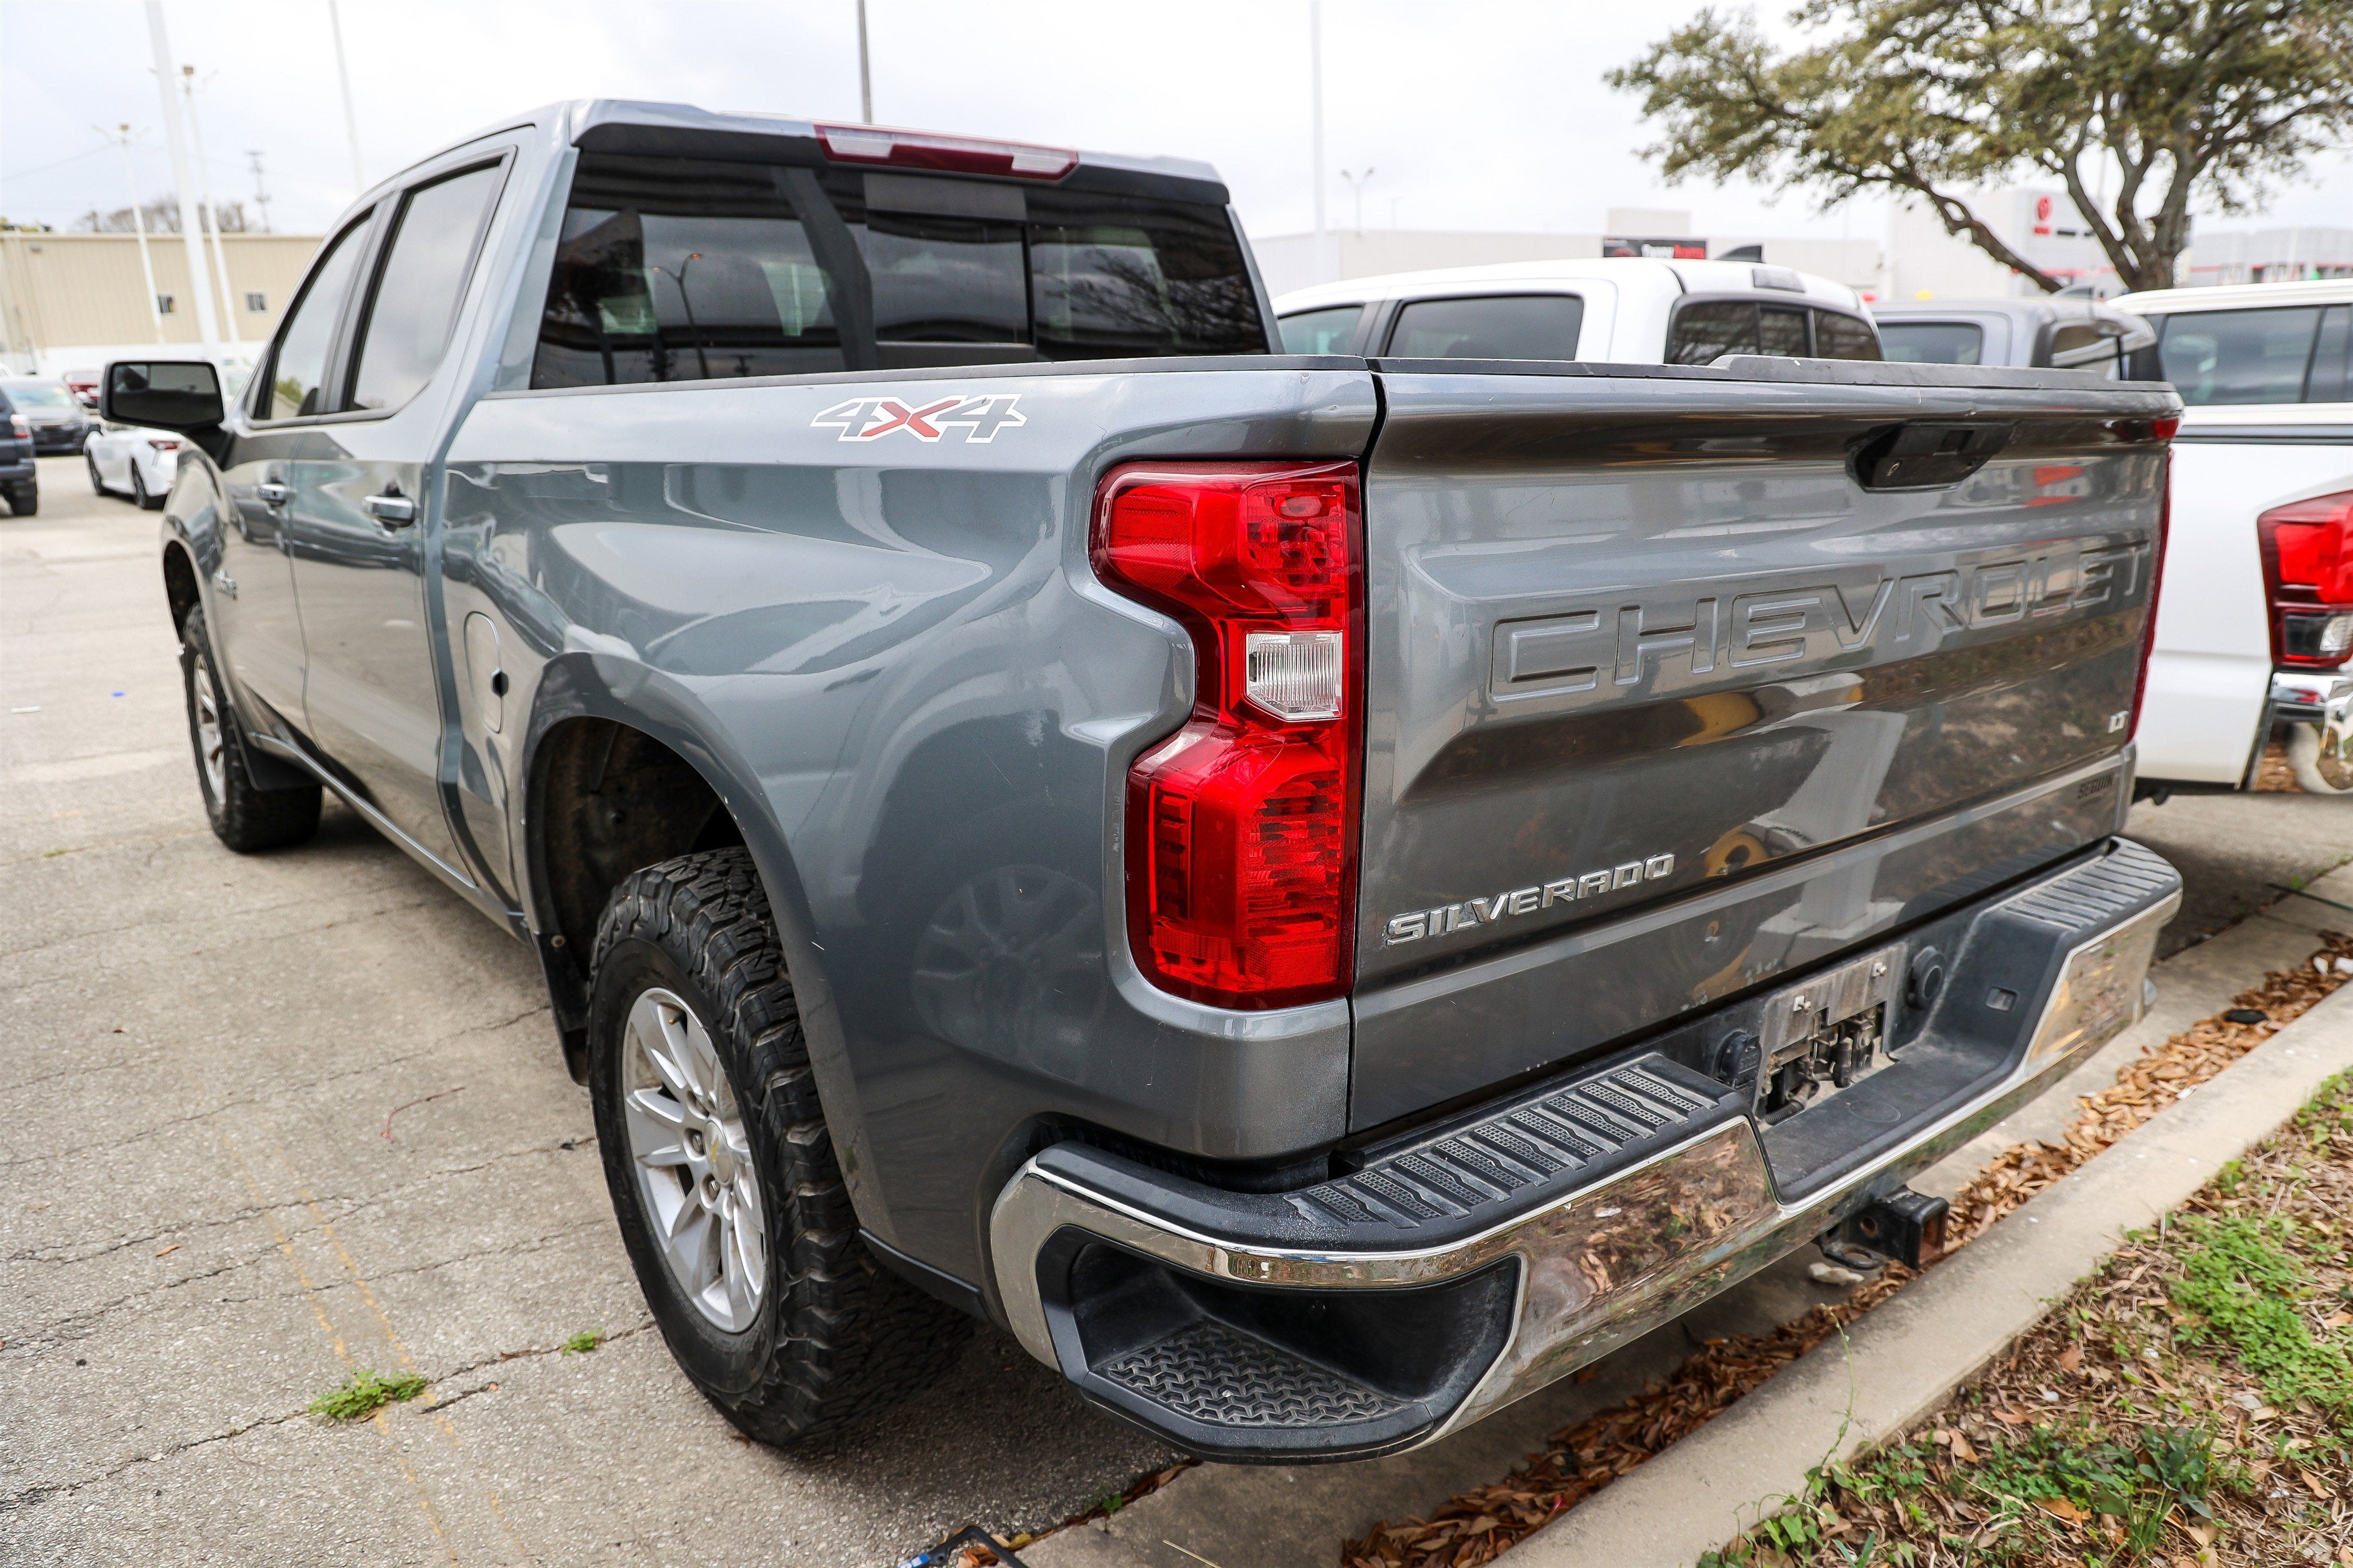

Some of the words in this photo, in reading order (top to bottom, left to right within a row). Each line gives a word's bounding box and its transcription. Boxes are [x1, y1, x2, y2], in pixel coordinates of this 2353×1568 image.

[1489, 539, 2151, 702] CHEVROLET
[2107, 710, 2130, 734] LT
[1386, 853, 1675, 947] SILVERADO
